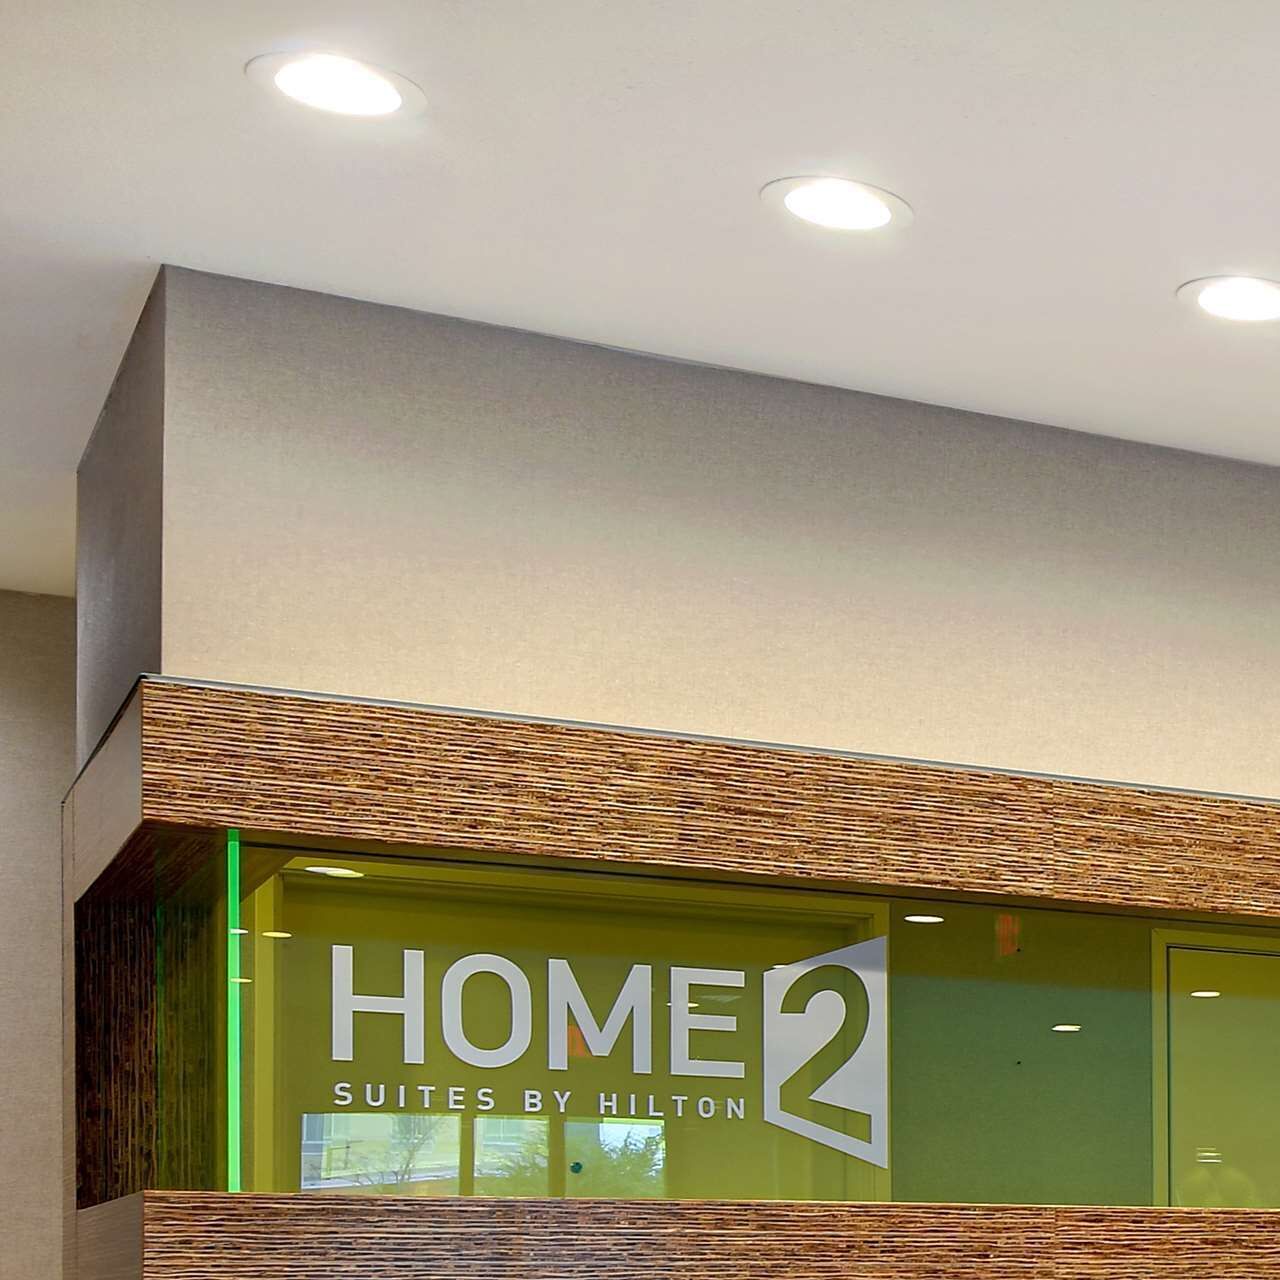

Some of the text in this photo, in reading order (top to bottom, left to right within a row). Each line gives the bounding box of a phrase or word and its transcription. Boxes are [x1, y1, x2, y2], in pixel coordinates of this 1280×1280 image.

[334, 1082, 745, 1120] SUITES BY HILTON
